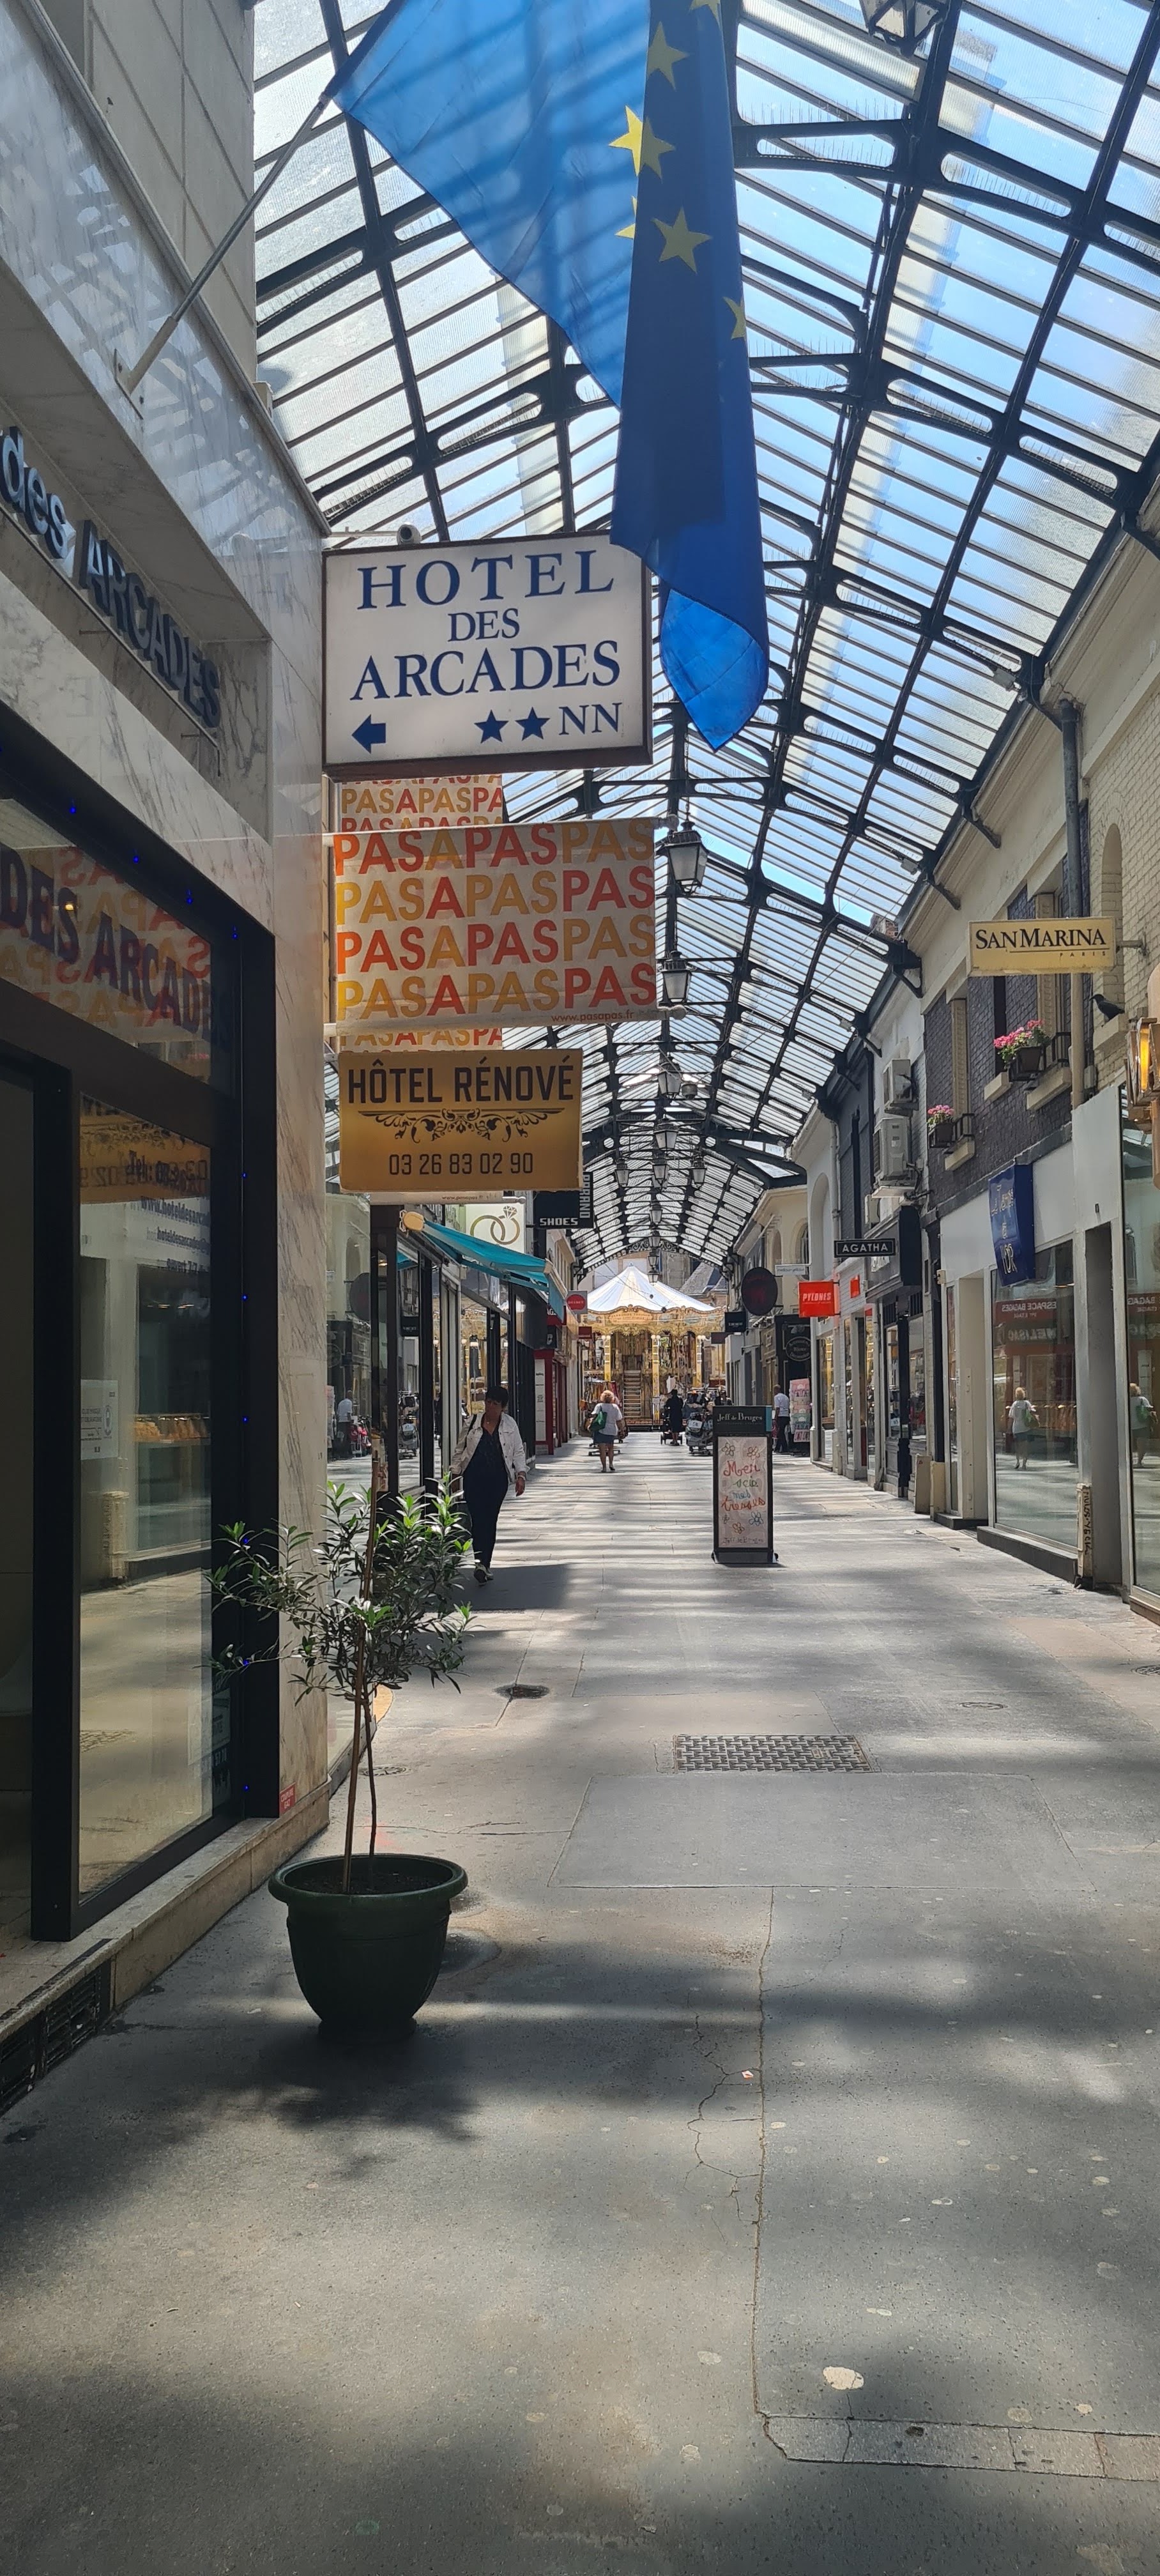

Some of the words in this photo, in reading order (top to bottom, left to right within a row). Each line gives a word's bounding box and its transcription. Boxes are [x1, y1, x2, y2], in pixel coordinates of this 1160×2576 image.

[356, 550, 614, 610] HOTEL
[79, 520, 221, 728] ARCADES
[447, 608, 520, 641] DES
[350, 640, 620, 700] ARCADES
[559, 703, 622, 735] NN
[1019, 928, 1106, 947] MARINA
[551, 1009, 634, 1022] www.pasapas.fr
[348, 1059, 442, 1103] HÔTEL
[454, 1055, 574, 1102] RÉNOVÉ
[389, 1154, 411, 1175] 03
[419, 1154, 441, 1175] 26
[450, 1153, 472, 1174] 83
[480, 1153, 502, 1174] 02
[510, 1153, 533, 1174] 90
[540, 1217, 578, 1226] SHOES
[842, 1243, 889, 1252] AGATHA
[802, 1292, 832, 1301] PYLONES
[717, 1413, 731, 1422] Jeff
[738, 1412, 763, 1422] Bruges
